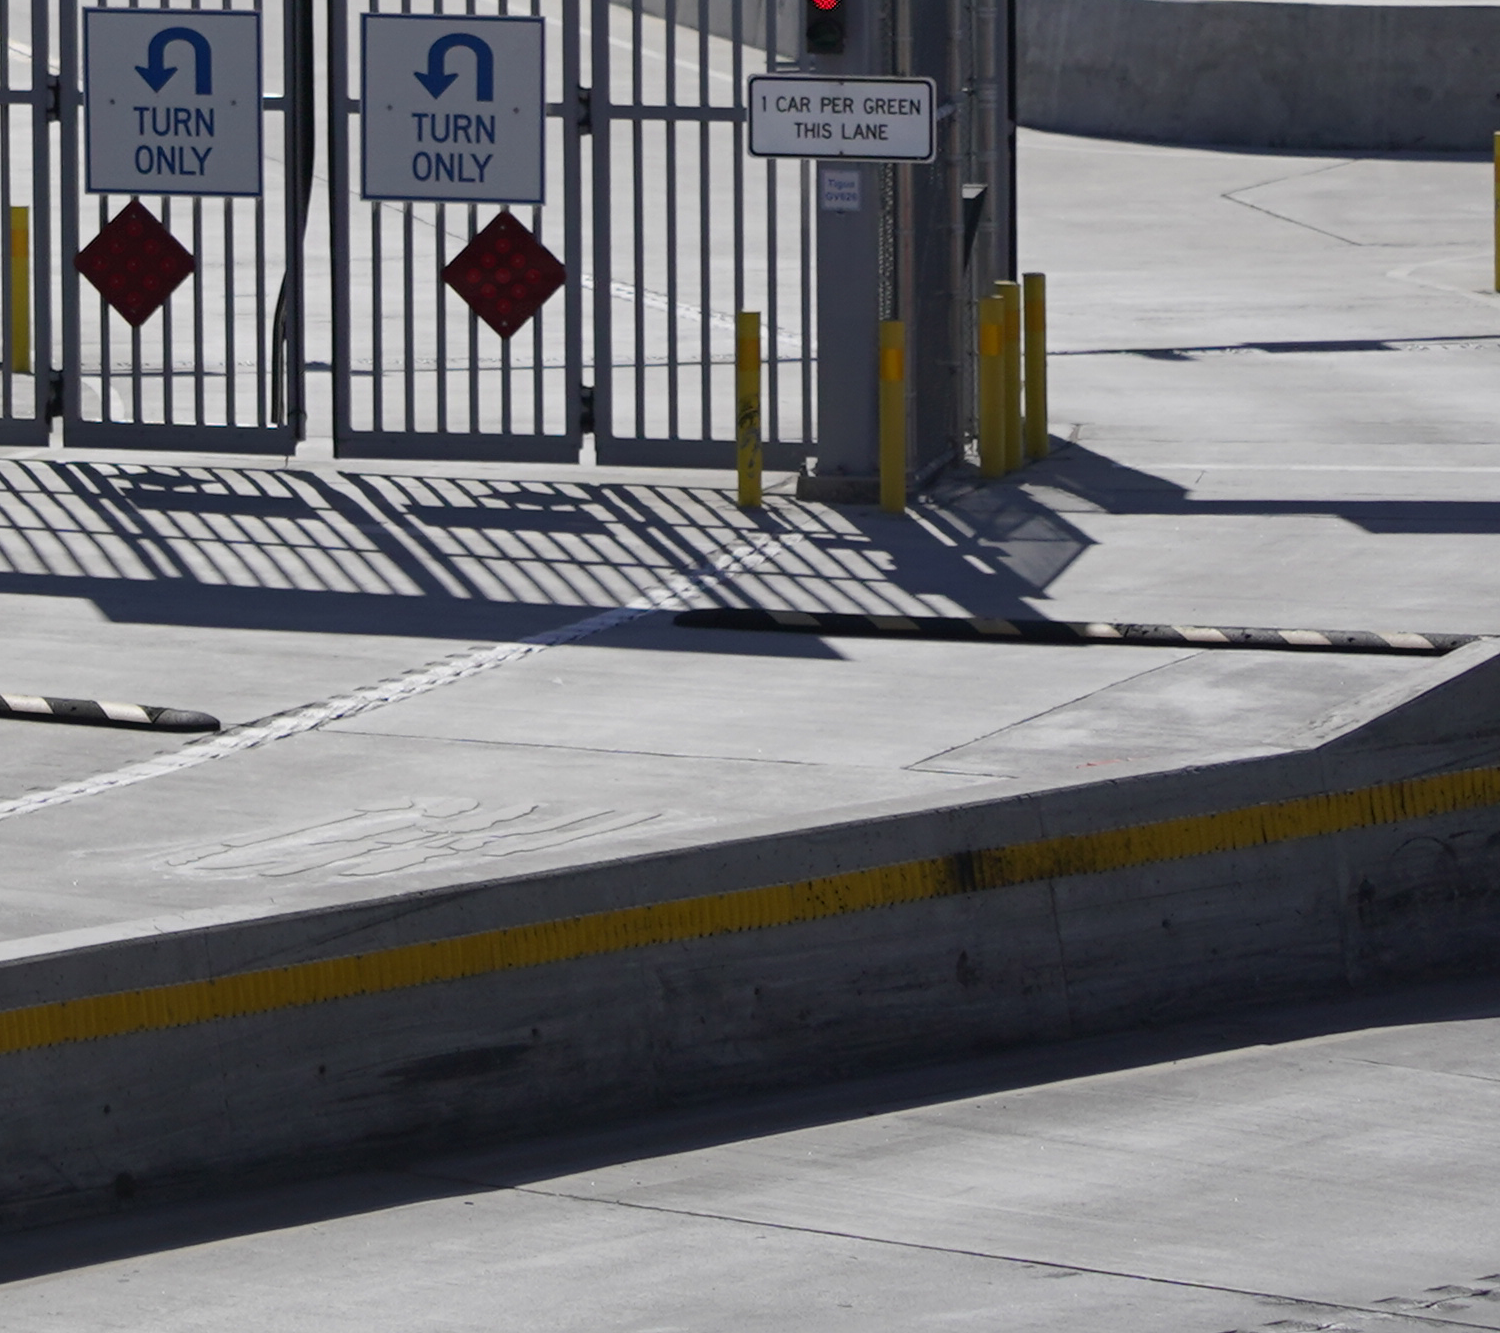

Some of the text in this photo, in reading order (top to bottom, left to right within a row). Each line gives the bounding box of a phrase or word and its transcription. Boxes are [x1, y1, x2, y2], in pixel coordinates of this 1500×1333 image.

[761, 96, 921, 115] 1 CAR PER GREEN
[133, 106, 215, 137] TURN
[411, 113, 495, 144] TURN
[794, 122, 889, 140] THIS LANE
[134, 144, 213, 176] ONLY
[412, 151, 494, 183] ONLY
